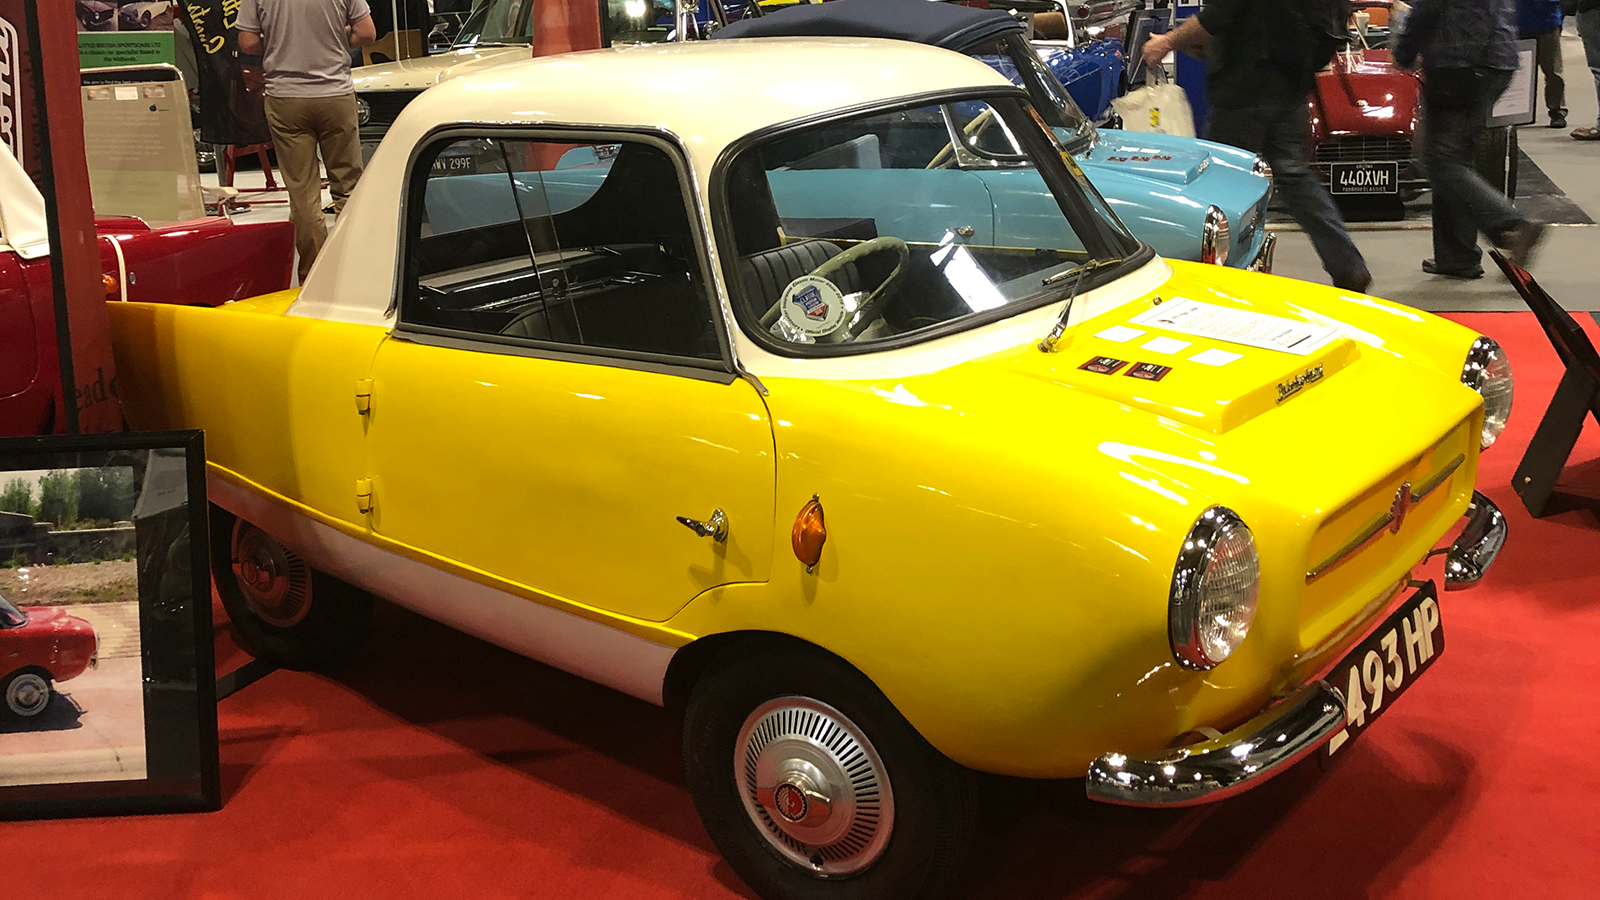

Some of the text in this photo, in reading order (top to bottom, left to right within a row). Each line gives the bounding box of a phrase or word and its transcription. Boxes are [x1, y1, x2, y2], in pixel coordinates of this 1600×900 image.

[449, 157, 471, 170] 299F
[792, 278, 808, 287] Classic
[1402, 596, 1439, 675] HP
